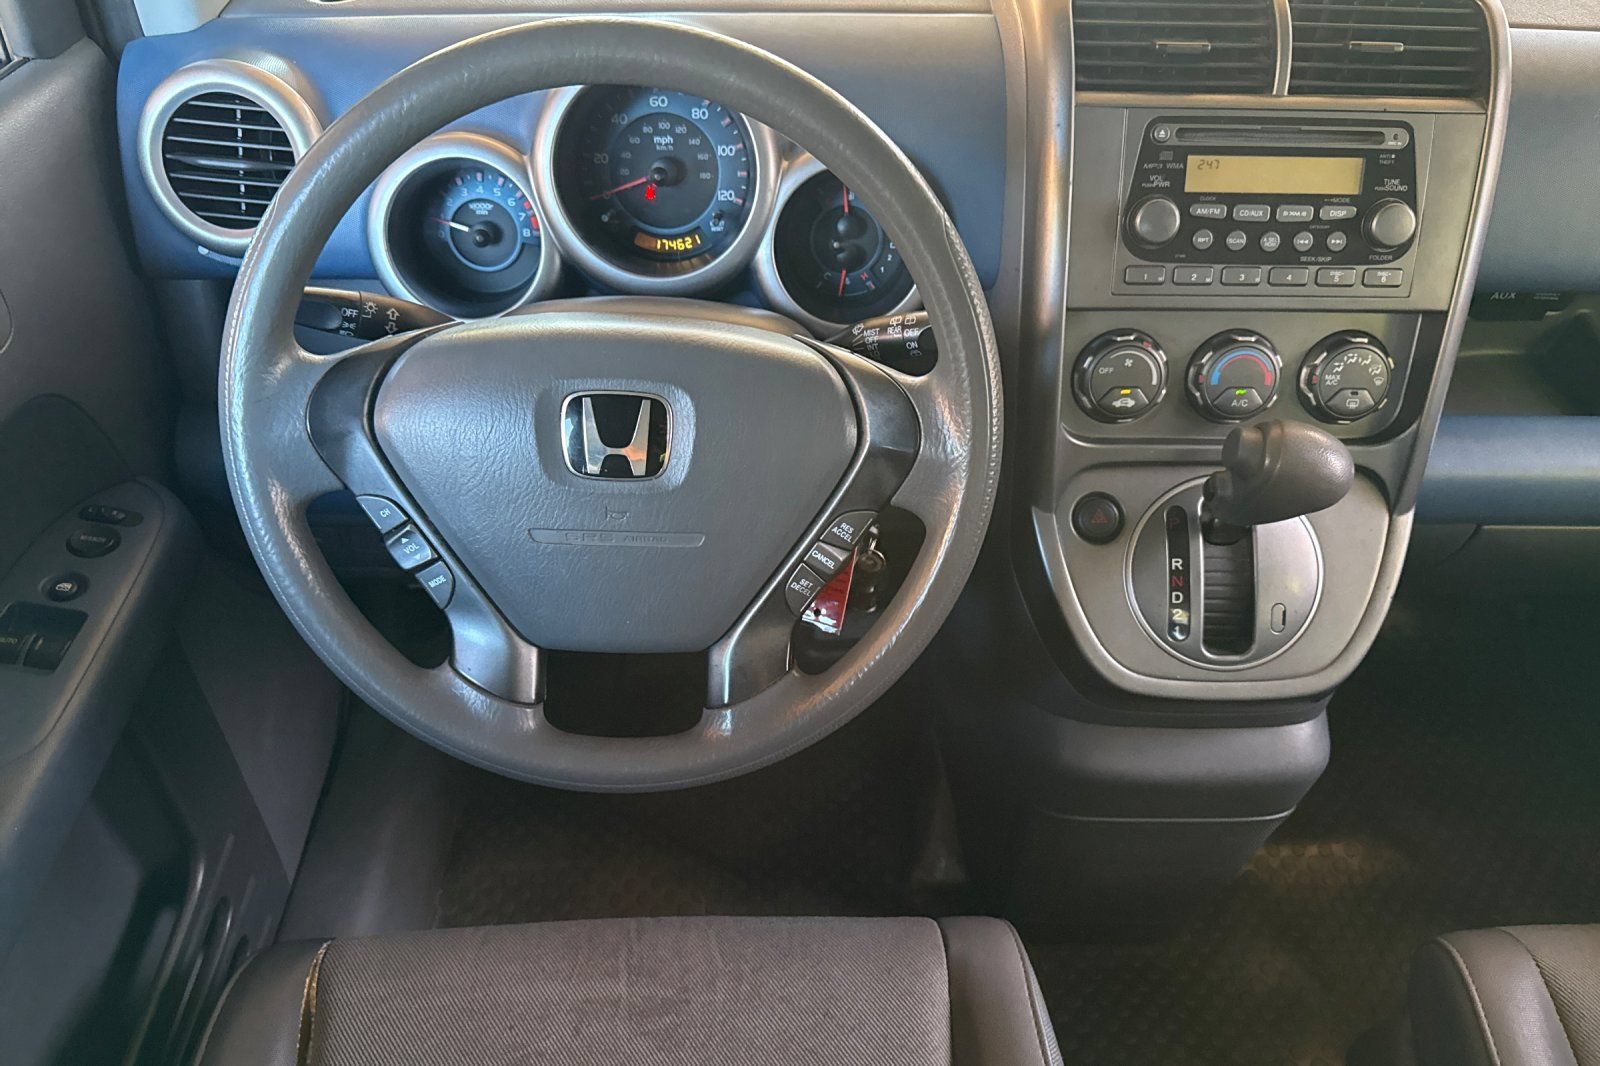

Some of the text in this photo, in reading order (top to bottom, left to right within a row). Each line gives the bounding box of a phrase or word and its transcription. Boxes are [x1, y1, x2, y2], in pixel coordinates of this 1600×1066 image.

[649, 96, 668, 108] 60
[611, 113, 628, 125] 40
[691, 108, 709, 120] 80
[658, 121, 671, 130] 100
[653, 135, 674, 146] mph
[717, 145, 736, 157] 100
[1384, 178, 1401, 187] TUNE
[461, 188, 469, 197] 3
[476, 186, 484, 194] 4
[493, 188, 502, 197] 5
[1385, 184, 1408, 192] SOUND
[717, 190, 736, 202] 120
[507, 199, 516, 207] 6
[518, 212, 526, 221] 7
[522, 228, 531, 238] 8
[656, 234, 701, 251] 174621
[887, 254, 893, 262] 2
[860, 271, 868, 281] H
[1143, 273, 1148, 281] 1
[1191, 273, 1197, 281] 2
[1239, 273, 1245, 281] 3
[1490, 292, 1517, 301] AUX
[341, 307, 359, 318] OFF
[863, 328, 880, 337] MIST
[887, 326, 902, 335] REAR
[903, 327, 920, 338] OFF
[865, 336, 879, 344] OFF
[906, 341, 919, 350] ON
[1231, 399, 1249, 408] A/C
[840, 521, 855, 534] RES
[831, 526, 853, 543] ACCEL
[403, 542, 420, 555] VOL
[811, 549, 836, 570] CANCEL
[1171, 558, 1183, 571] R
[428, 574, 447, 589] MODE
[800, 578, 814, 589] SET
[1171, 576, 1185, 588] N
[790, 581, 812, 597] DECEL
[1172, 591, 1184, 604] D
[1172, 608, 1184, 621] 2
